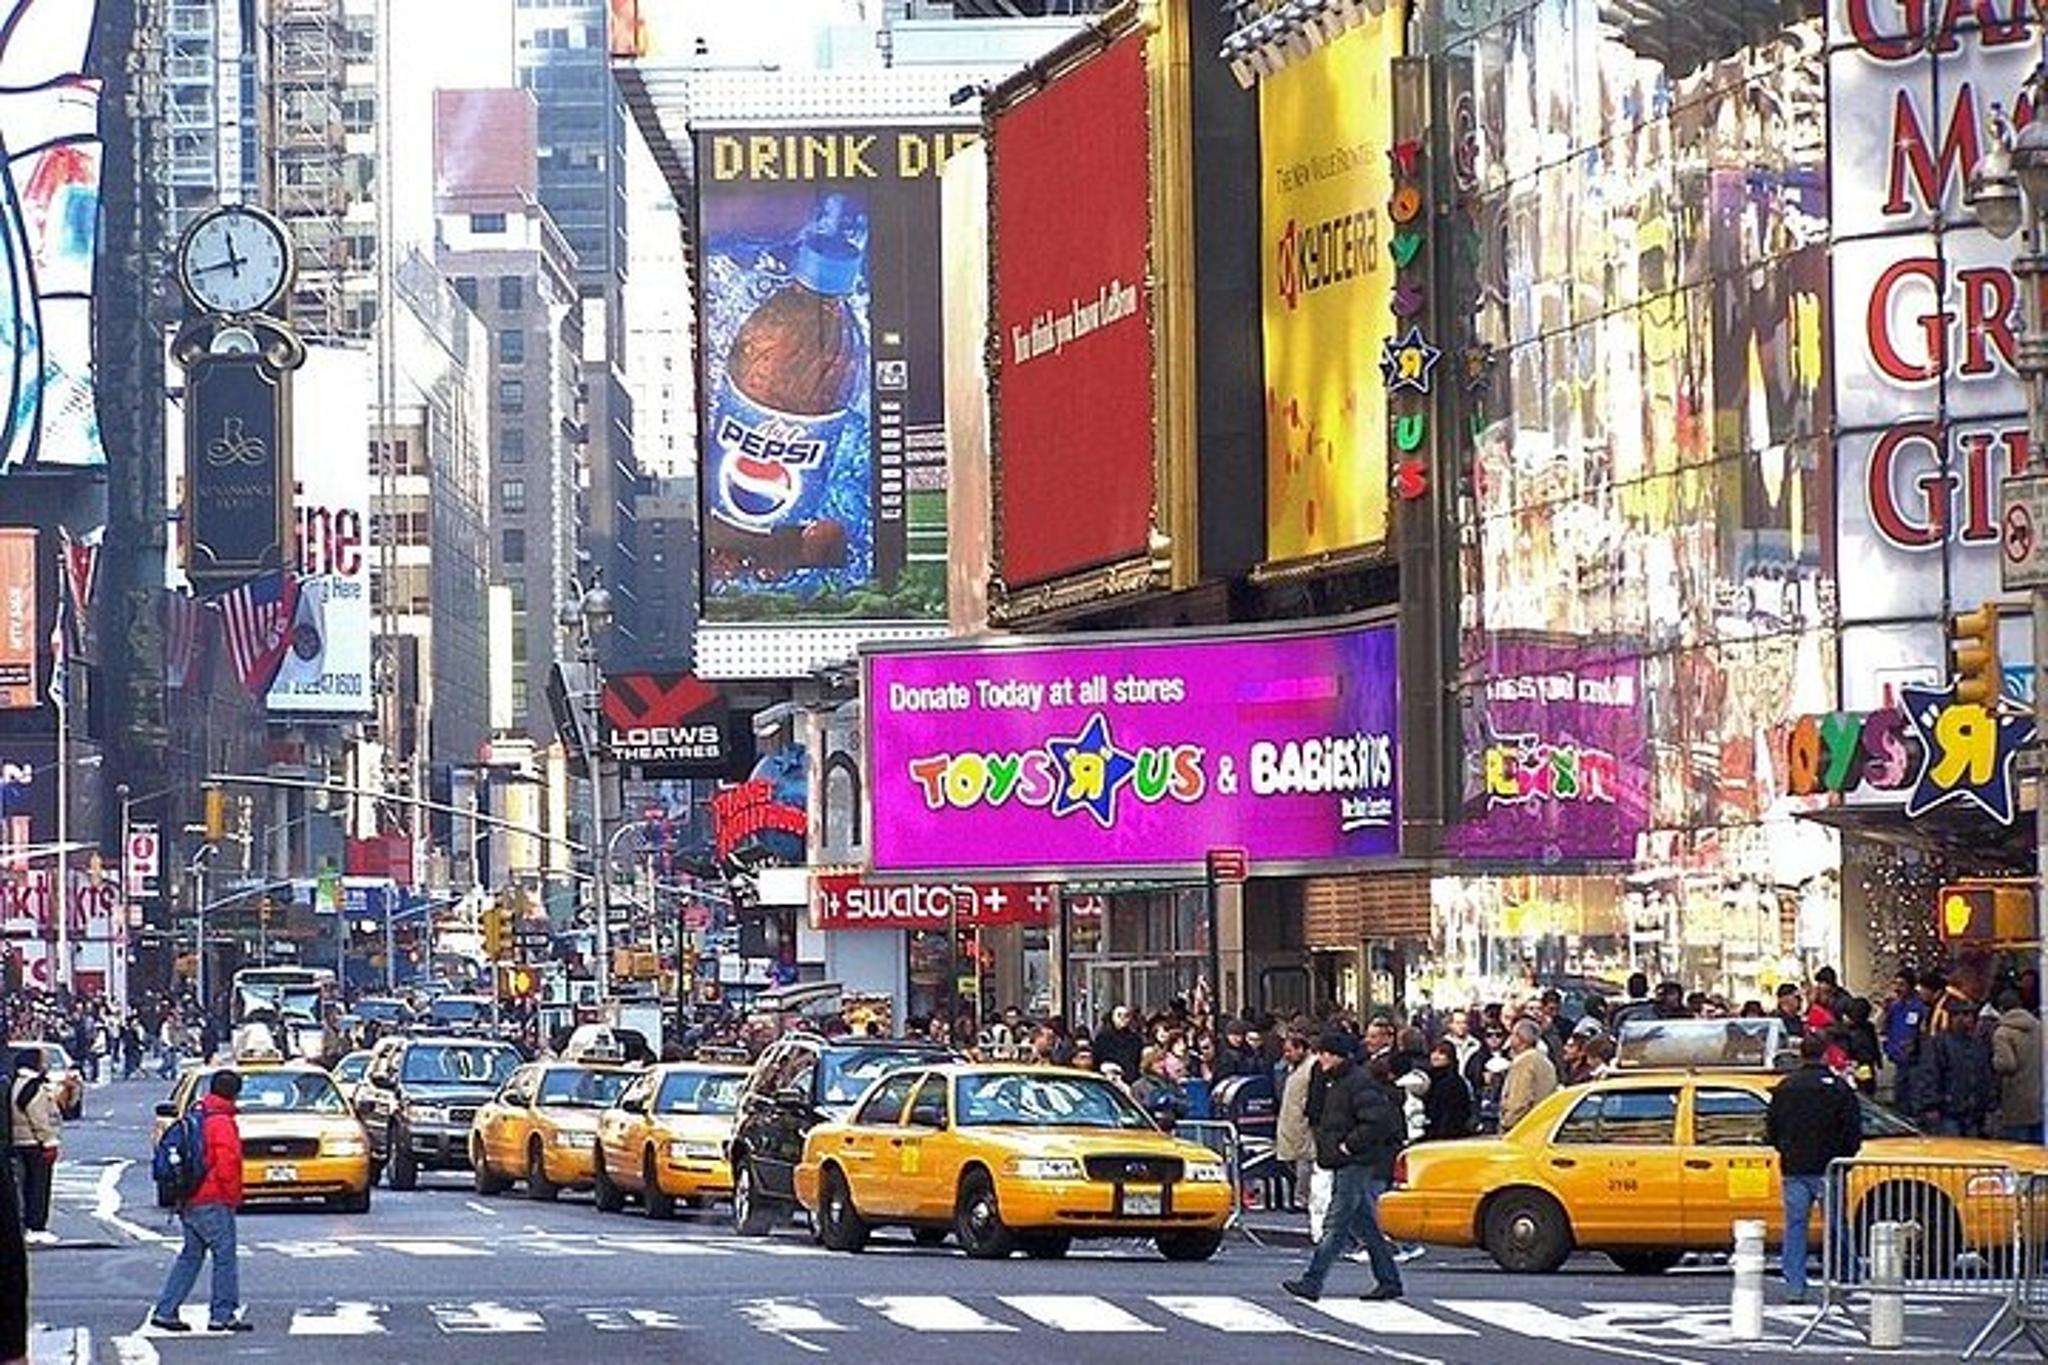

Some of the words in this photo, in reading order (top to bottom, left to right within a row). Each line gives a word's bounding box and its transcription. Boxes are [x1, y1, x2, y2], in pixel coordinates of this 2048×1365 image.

[713, 136, 877, 180] DRINK
[721, 419, 821, 464] PEPSI
[890, 682, 970, 711] Donate
[974, 679, 1043, 712] Today
[1049, 677, 1074, 705] at
[1079, 675, 1107, 704] all
[1112, 675, 1185, 704] stores
[611, 725, 719, 746] LOEWS
[611, 744, 720, 760] THEATRES
[910, 750, 1056, 810] TOYS
[1135, 746, 1208, 803] US
[1217, 754, 1239, 795] &
